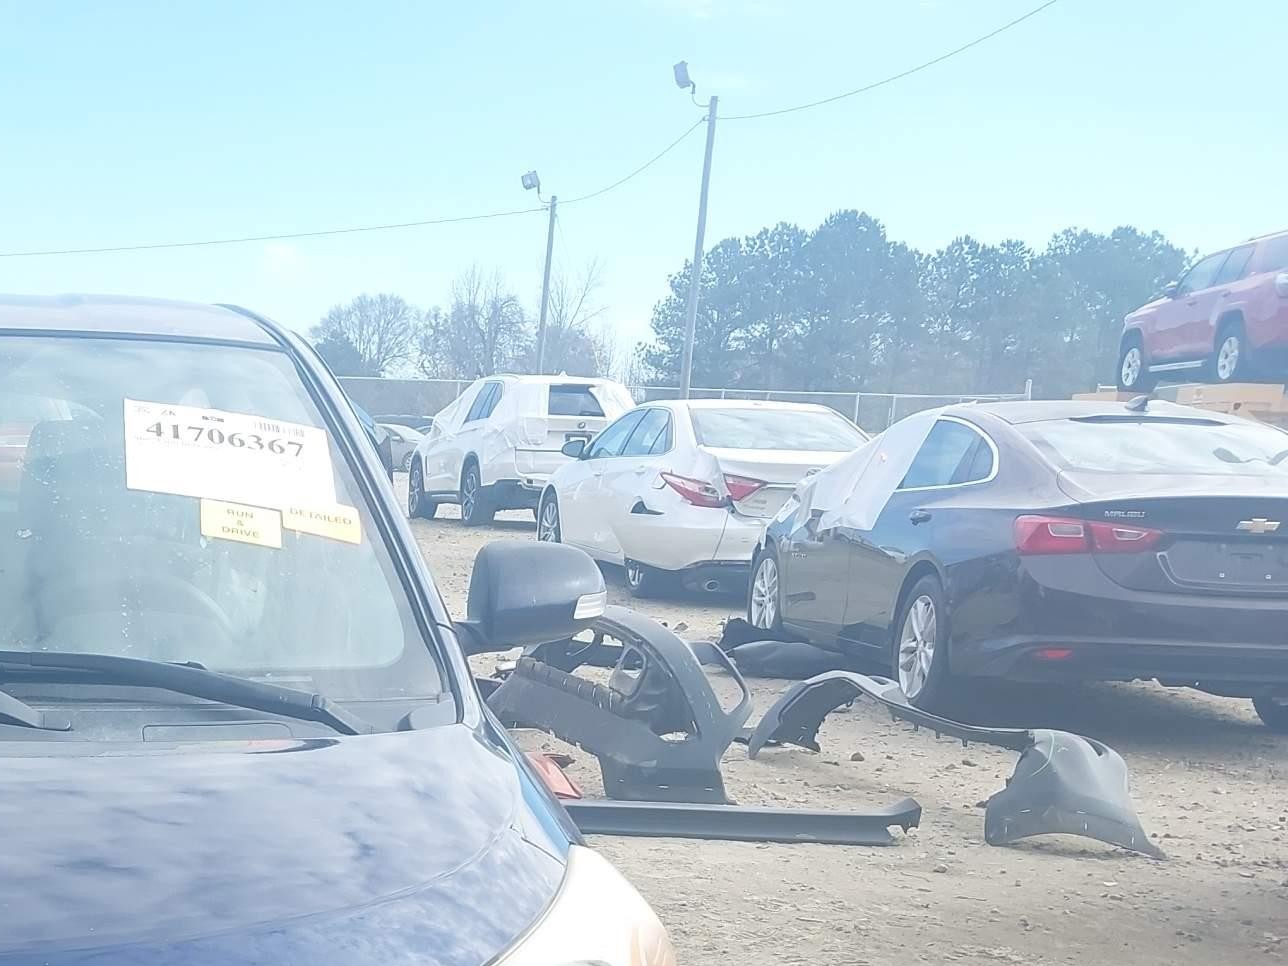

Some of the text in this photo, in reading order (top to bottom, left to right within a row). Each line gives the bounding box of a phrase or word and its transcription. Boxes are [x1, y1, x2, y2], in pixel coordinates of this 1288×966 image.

[145, 421, 304, 457] 41706367
[226, 508, 254, 519] RUN
[289, 507, 352, 525] DETAILED
[222, 526, 260, 538] DRIVE
